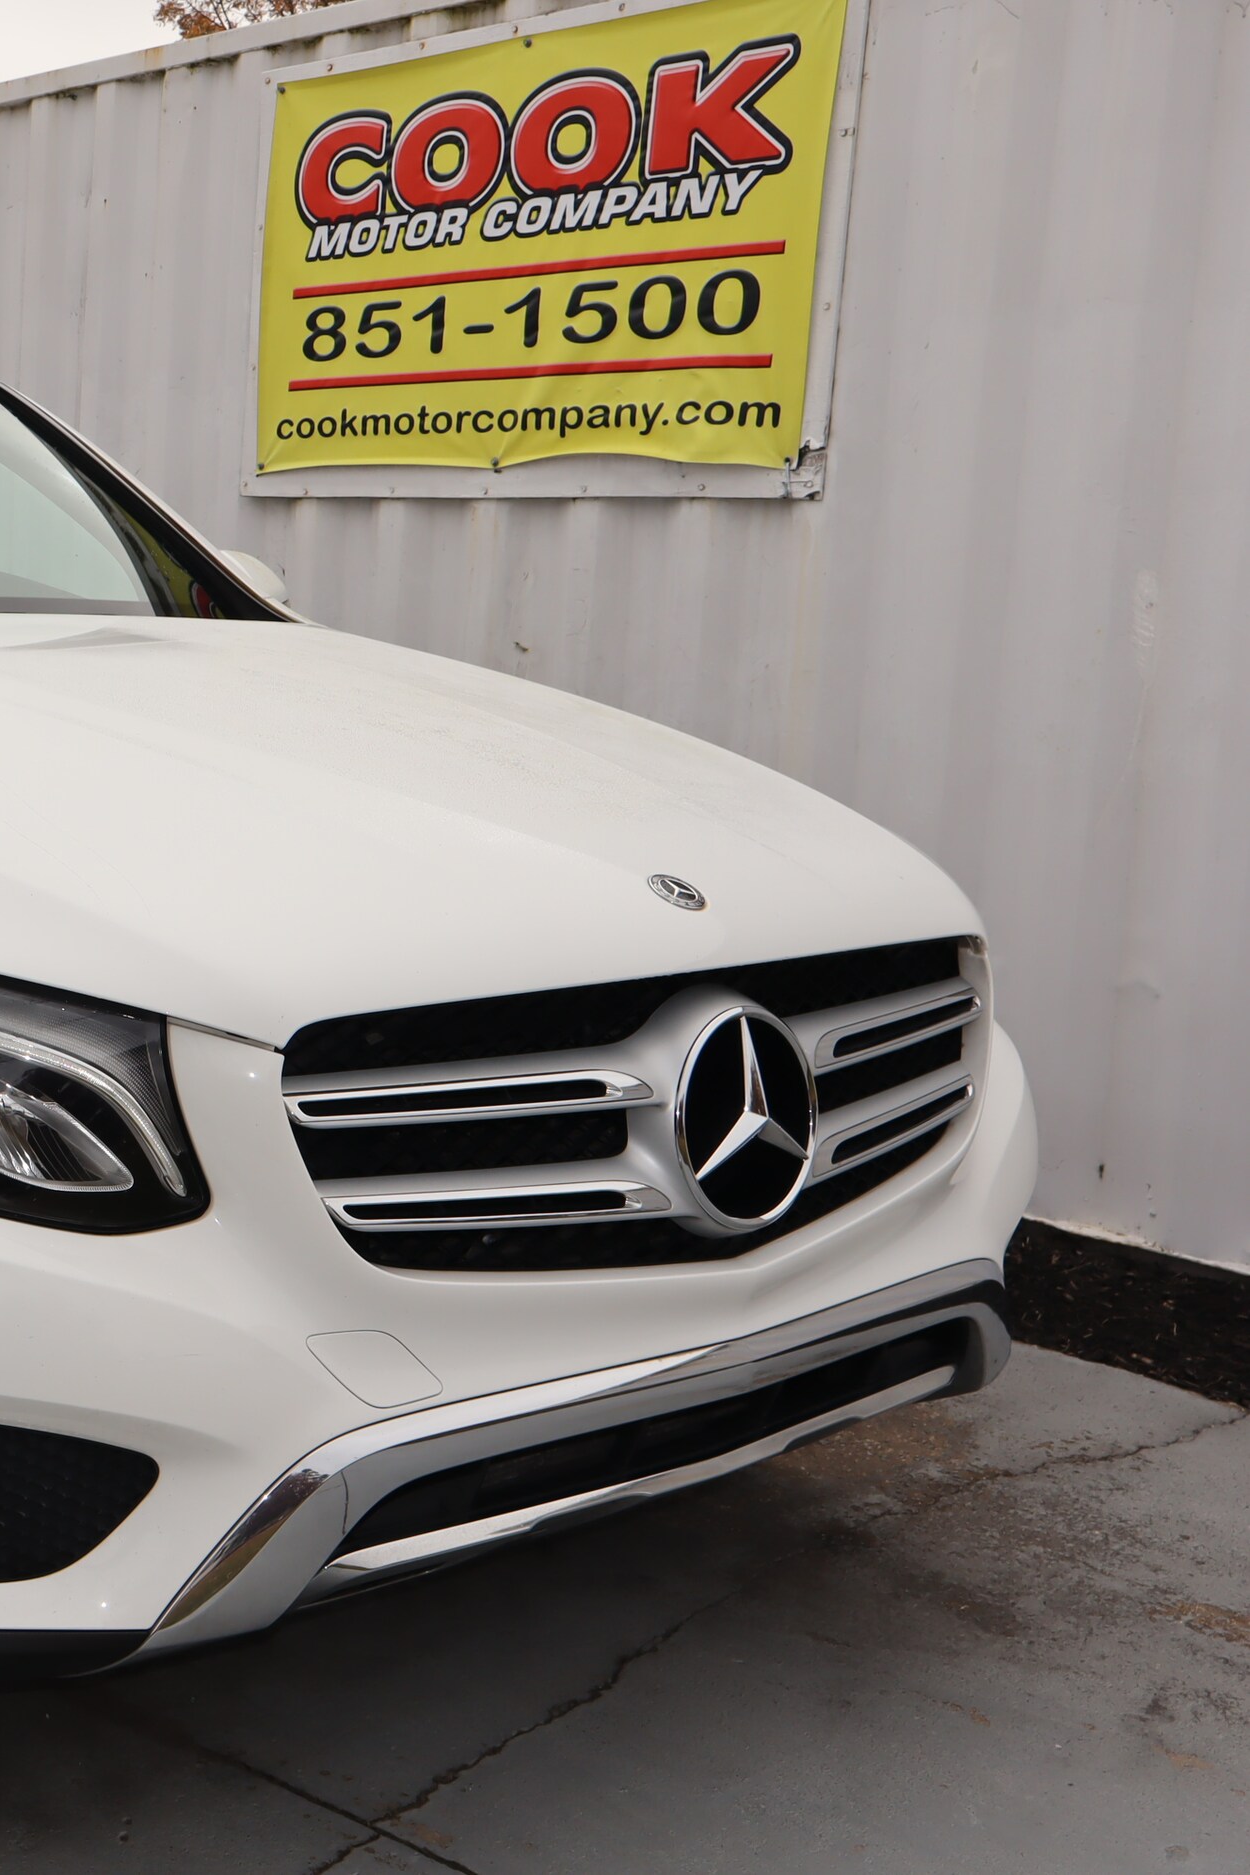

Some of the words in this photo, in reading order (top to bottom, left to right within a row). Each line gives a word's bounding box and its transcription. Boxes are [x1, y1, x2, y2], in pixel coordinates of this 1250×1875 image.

[296, 35, 800, 222] COOK
[306, 206, 468, 259] MOTOR
[482, 169, 764, 238] COMPANY
[302, 269, 761, 362] 851-1500
[276, 399, 782, 440] cookmotorcompany.com
